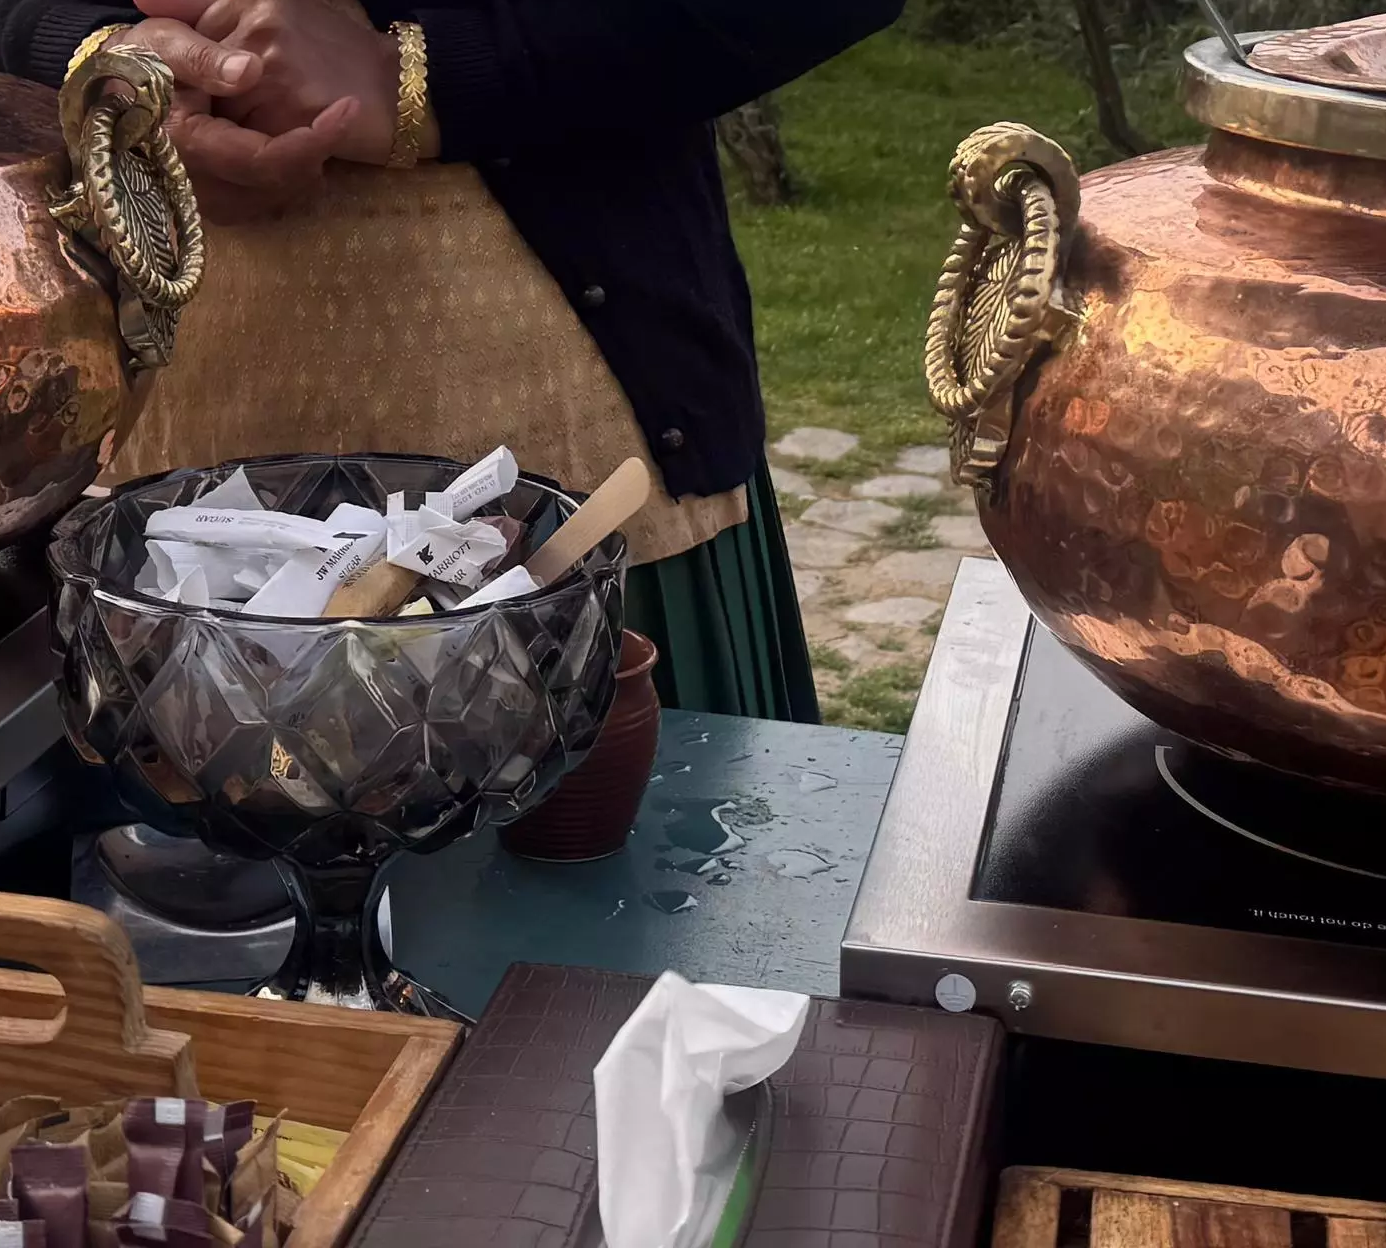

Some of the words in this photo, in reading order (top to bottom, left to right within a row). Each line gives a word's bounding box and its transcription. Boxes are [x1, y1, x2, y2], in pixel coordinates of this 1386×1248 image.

[338, 554, 362, 579] SUGAR
[315, 565, 329, 581] JW
[1268, 911, 1315, 922] touch
[1320, 917, 1346, 926] not
[1351, 921, 1372, 929] do
